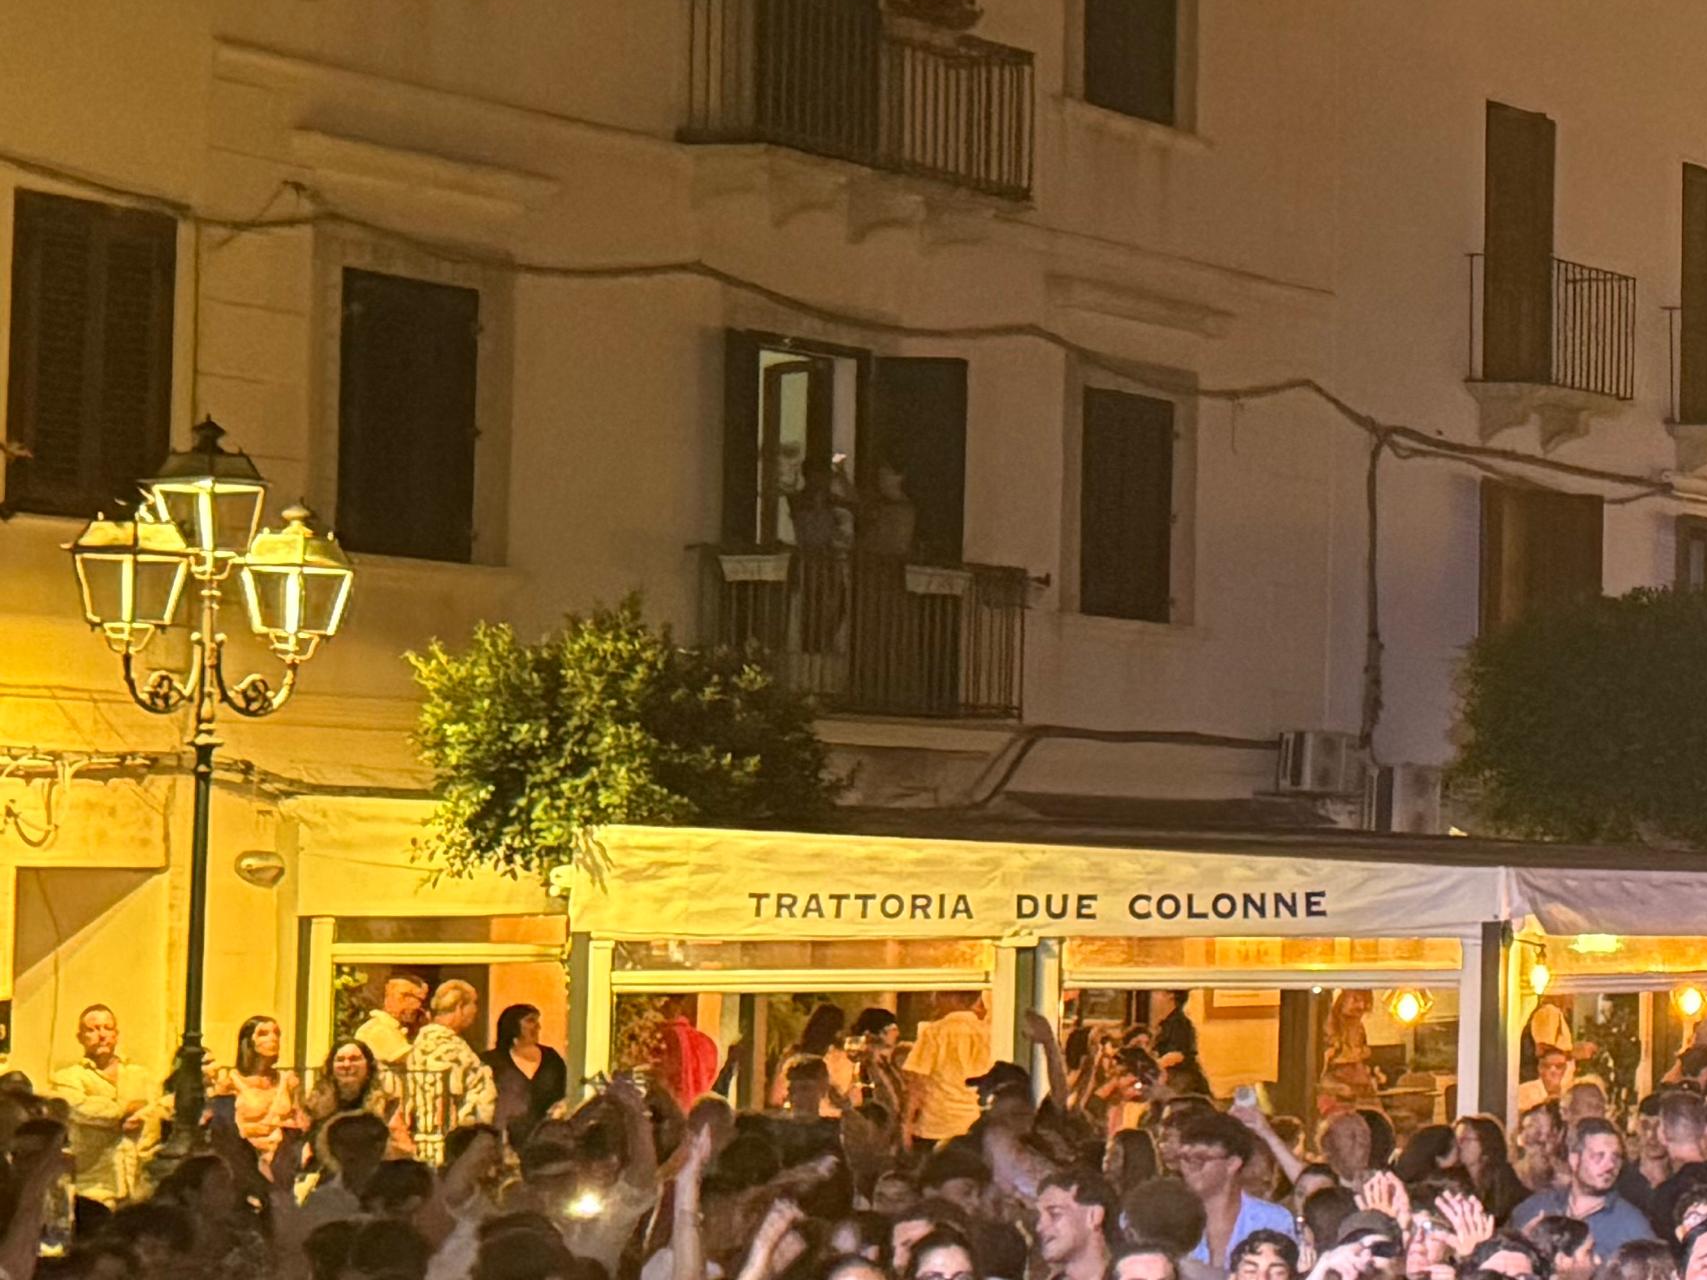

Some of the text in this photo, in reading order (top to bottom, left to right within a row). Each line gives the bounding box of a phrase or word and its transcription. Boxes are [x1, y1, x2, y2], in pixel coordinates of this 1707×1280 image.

[748, 890, 1329, 920] TRATTORIA DUE COLONNE
